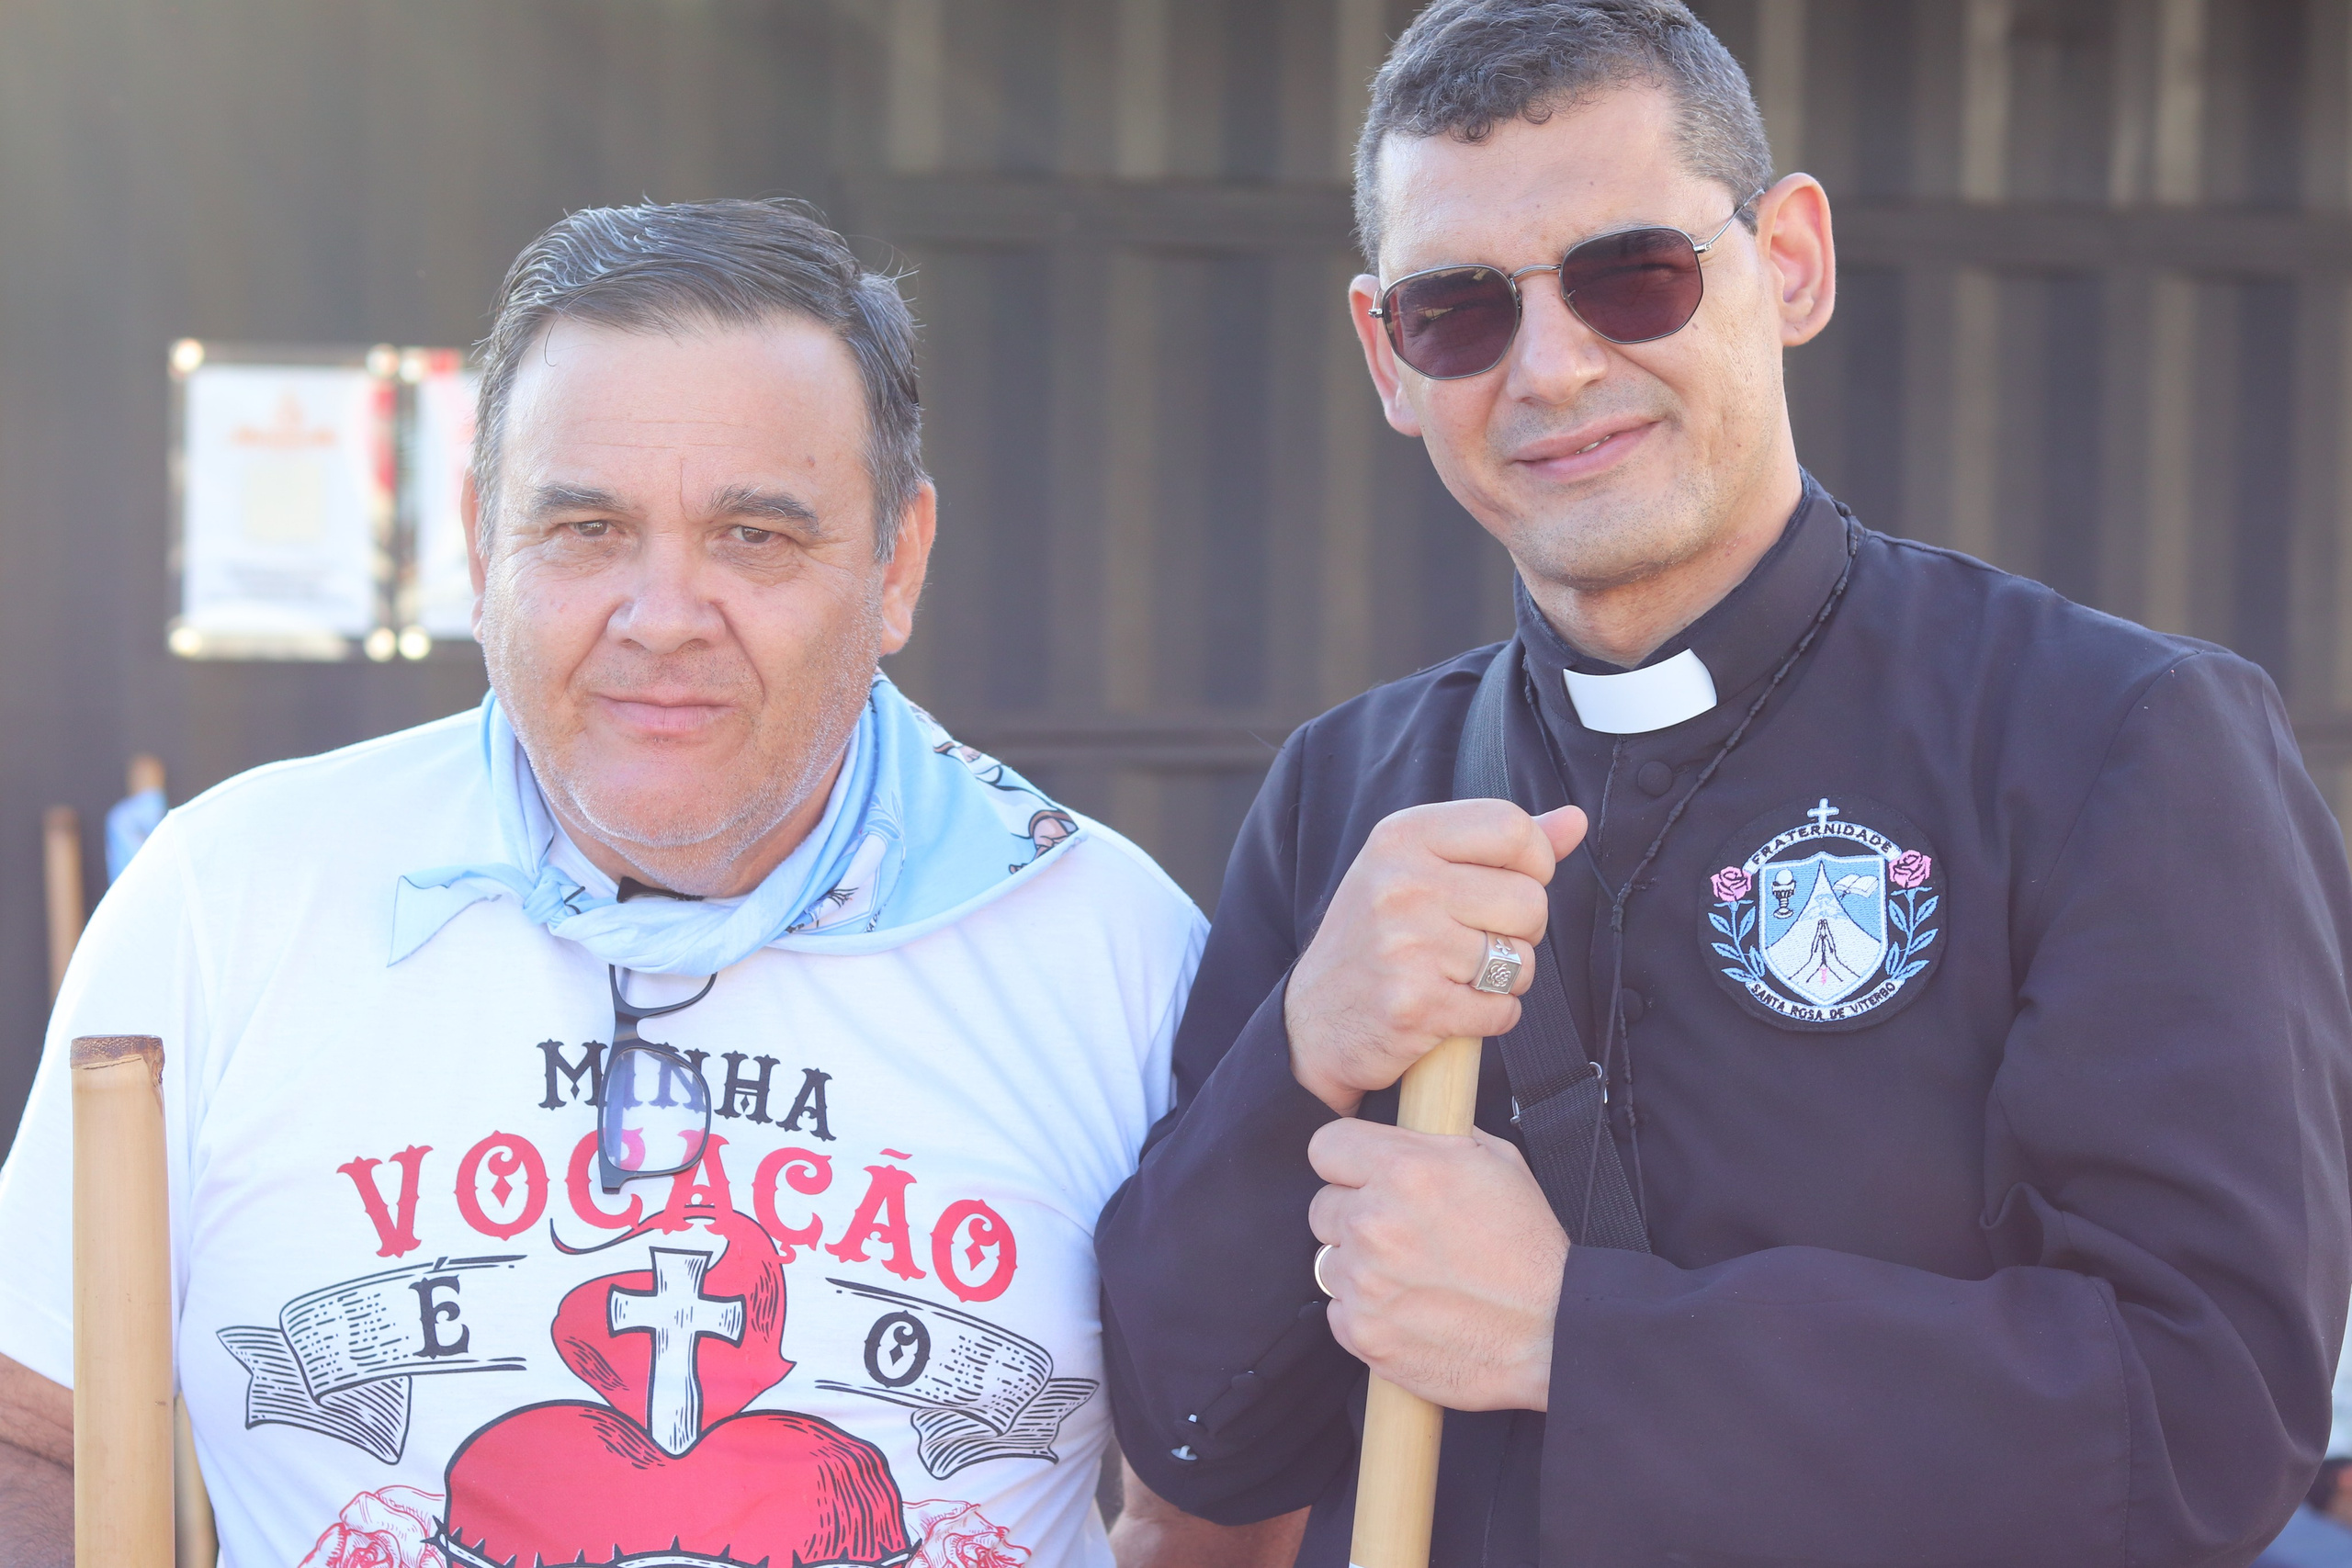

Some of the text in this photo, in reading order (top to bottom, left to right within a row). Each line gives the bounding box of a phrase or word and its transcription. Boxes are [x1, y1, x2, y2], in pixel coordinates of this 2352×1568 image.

[1752, 823, 1893, 865] FRATERNIDADE
[1751, 981, 1897, 1021] SANTA ROSA DE VITERBO
[537, 1038, 837, 1142] MINHA
[336, 1130, 1018, 1303] VOCAÇÃO
[412, 1257, 932, 1389] É O
